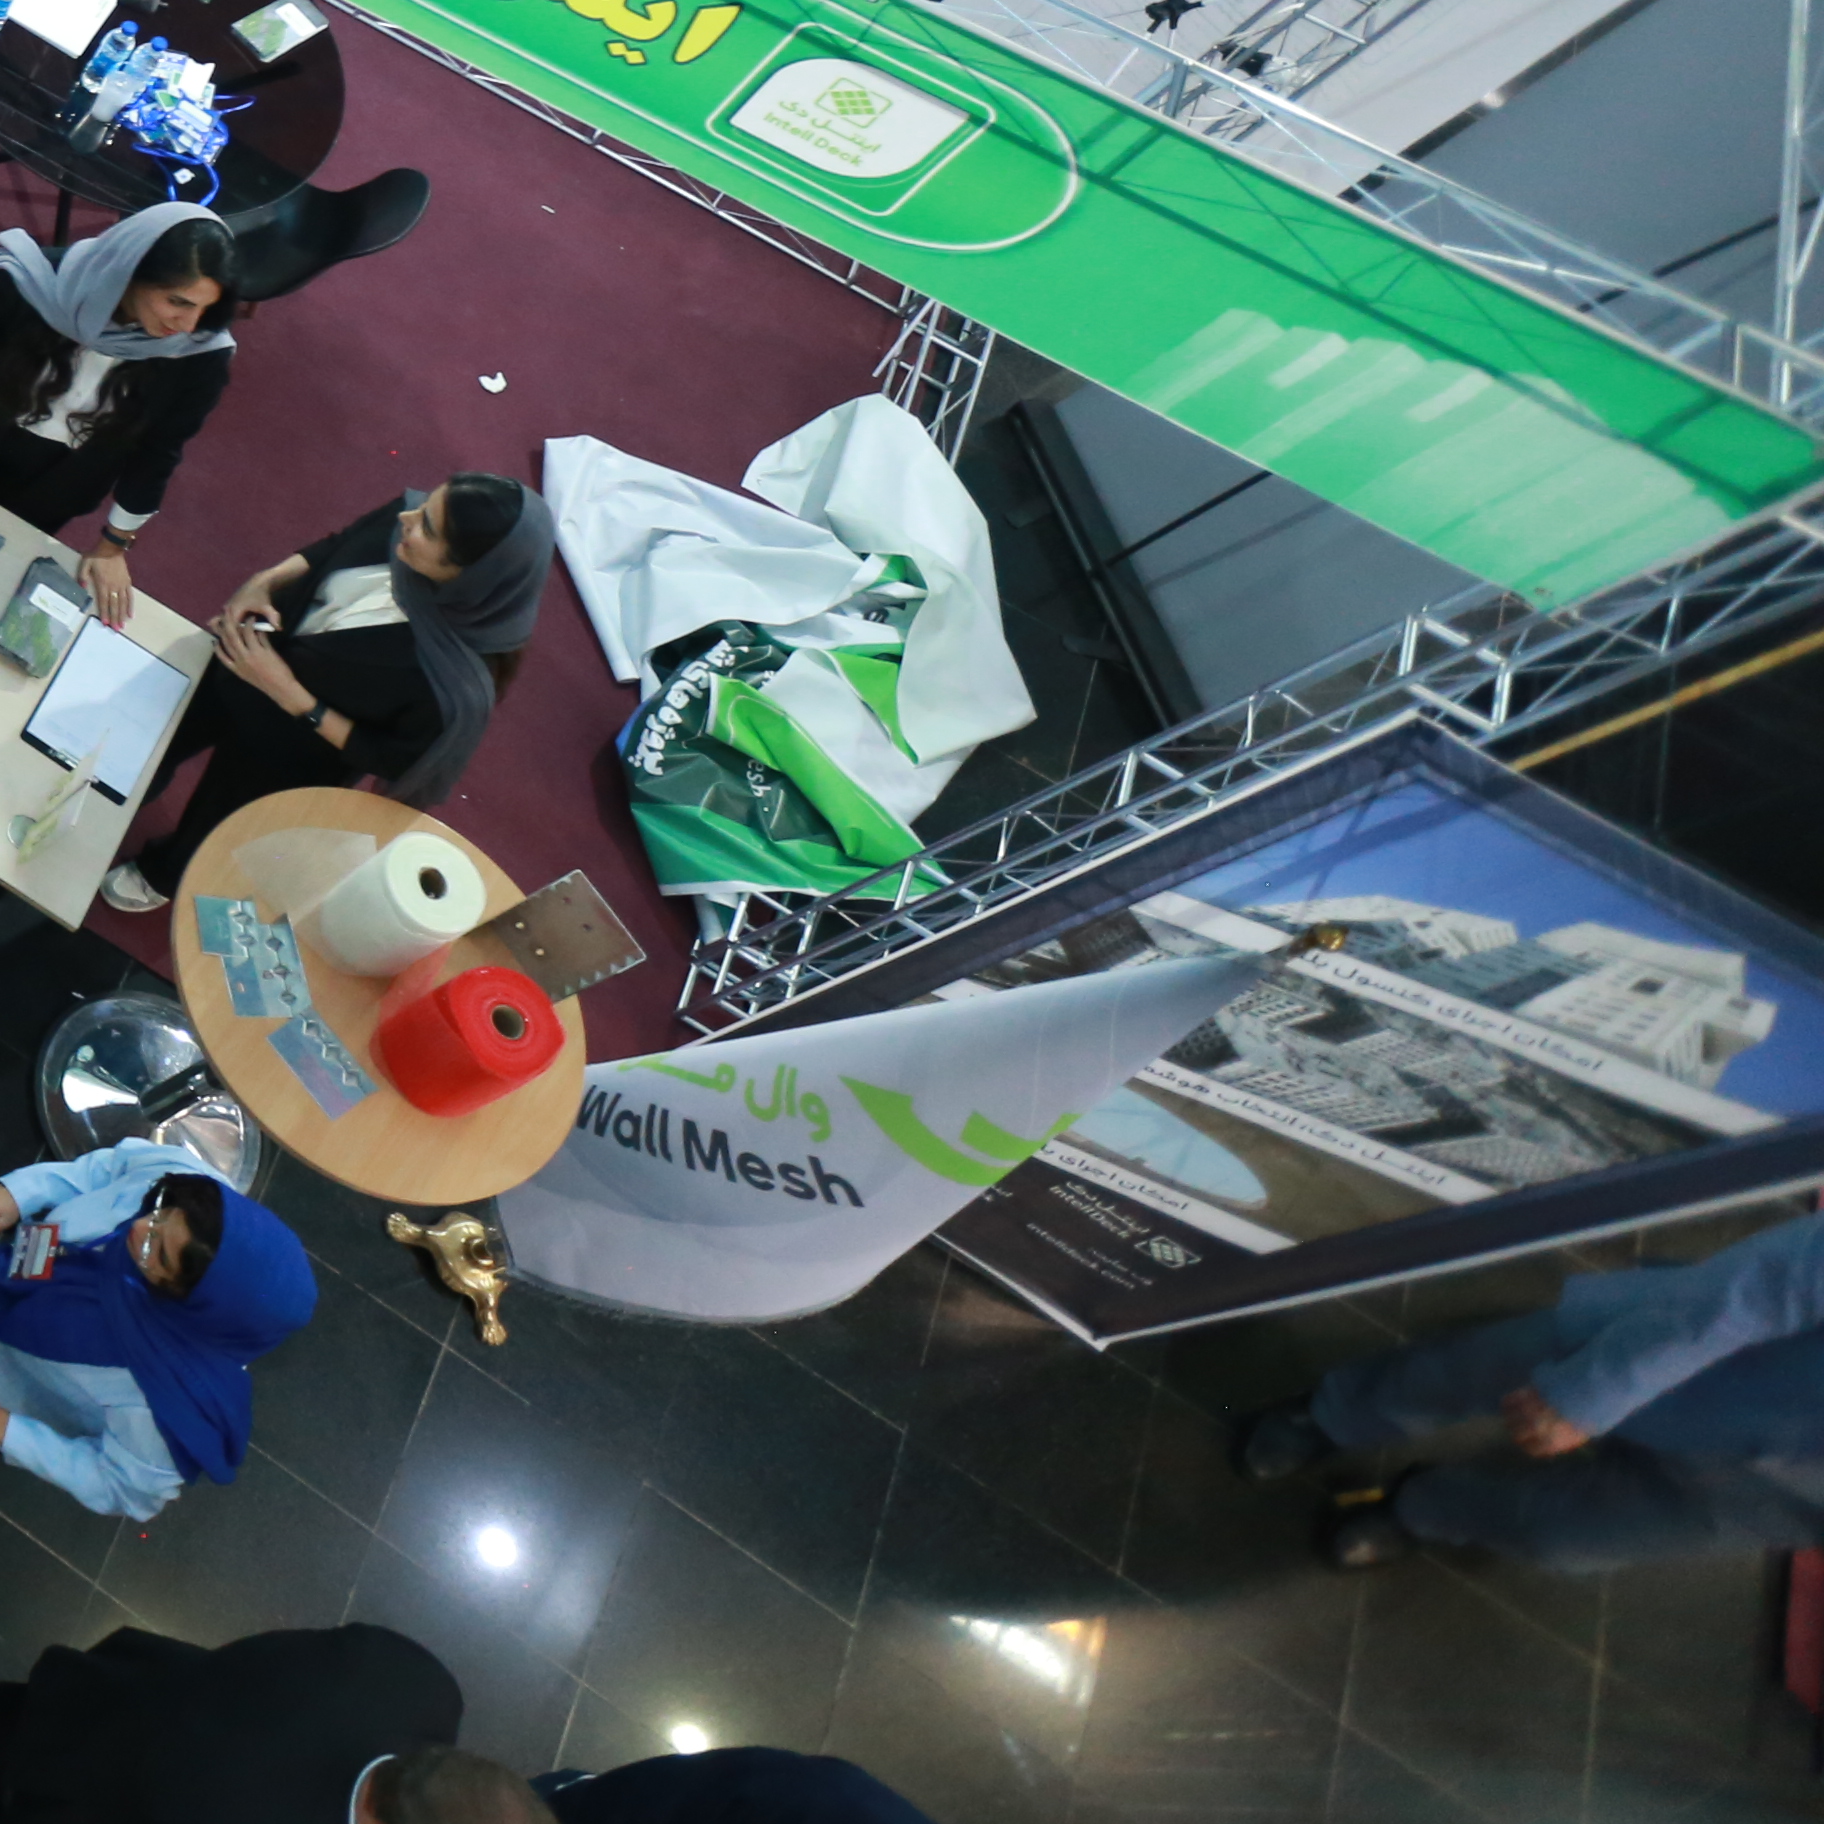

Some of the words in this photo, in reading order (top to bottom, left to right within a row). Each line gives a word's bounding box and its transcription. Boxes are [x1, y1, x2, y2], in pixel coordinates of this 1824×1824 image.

[763, 111, 814, 142] Intell
[813, 136, 862, 167] Deck
[810, 118, 883, 153] اینتل
[745, 1064, 834, 1143] وال
[578, 1081, 673, 1163] Wall
[680, 1118, 867, 1210] Mesh
